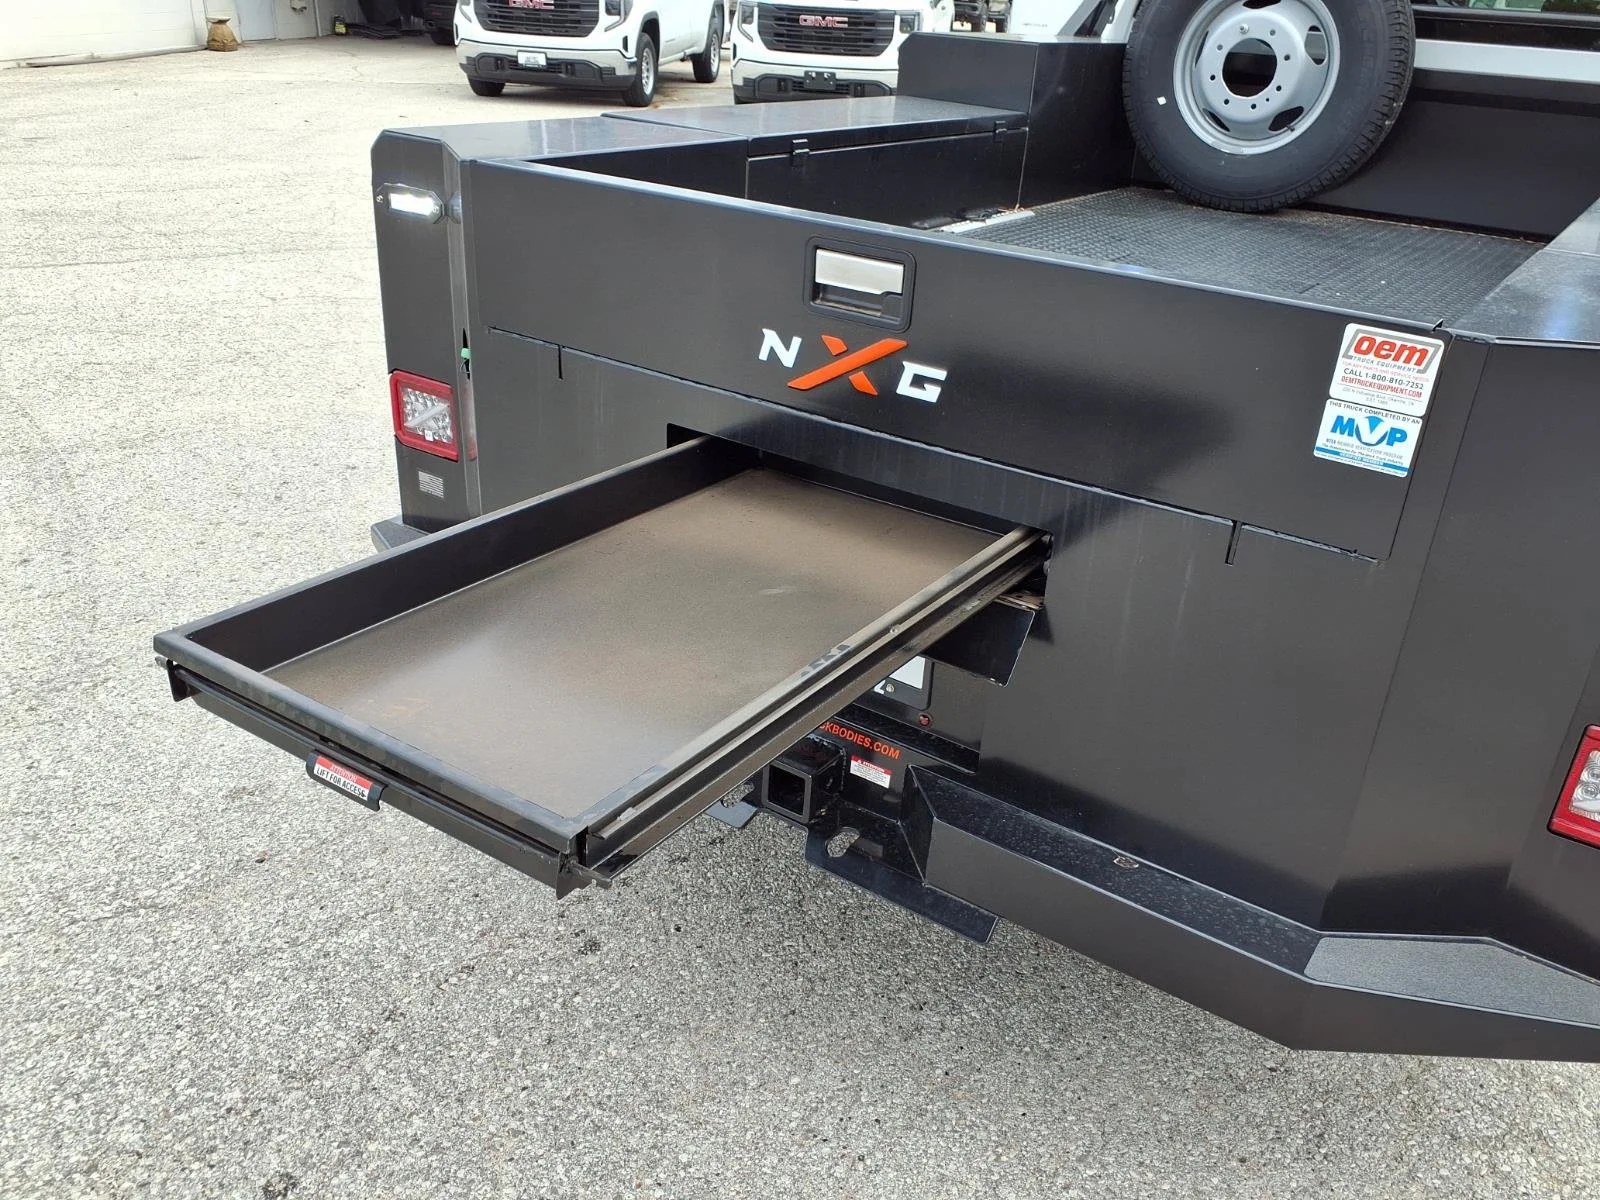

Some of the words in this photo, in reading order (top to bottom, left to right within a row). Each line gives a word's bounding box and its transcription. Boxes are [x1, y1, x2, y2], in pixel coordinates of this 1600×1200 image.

[508, 0, 554, 9] GMC
[799, 14, 849, 28] GMC
[1353, 335, 1429, 367] oem
[1352, 355, 1374, 364] TRUCK
[1376, 360, 1416, 373] EQUIPMENT
[1340, 375, 1422, 398] OEMTRUCKEQUIPMENT.COM
[1343, 367, 1363, 377] CALL
[1364, 372, 1424, 390] 1-800-810-7252
[1342, 403, 1363, 412] TRUCK
[1363, 408, 1400, 421] COMPLETED
[316, 768, 329, 778] LIFT
[329, 774, 342, 785] FOR
[341, 780, 366, 797] ACCESS
